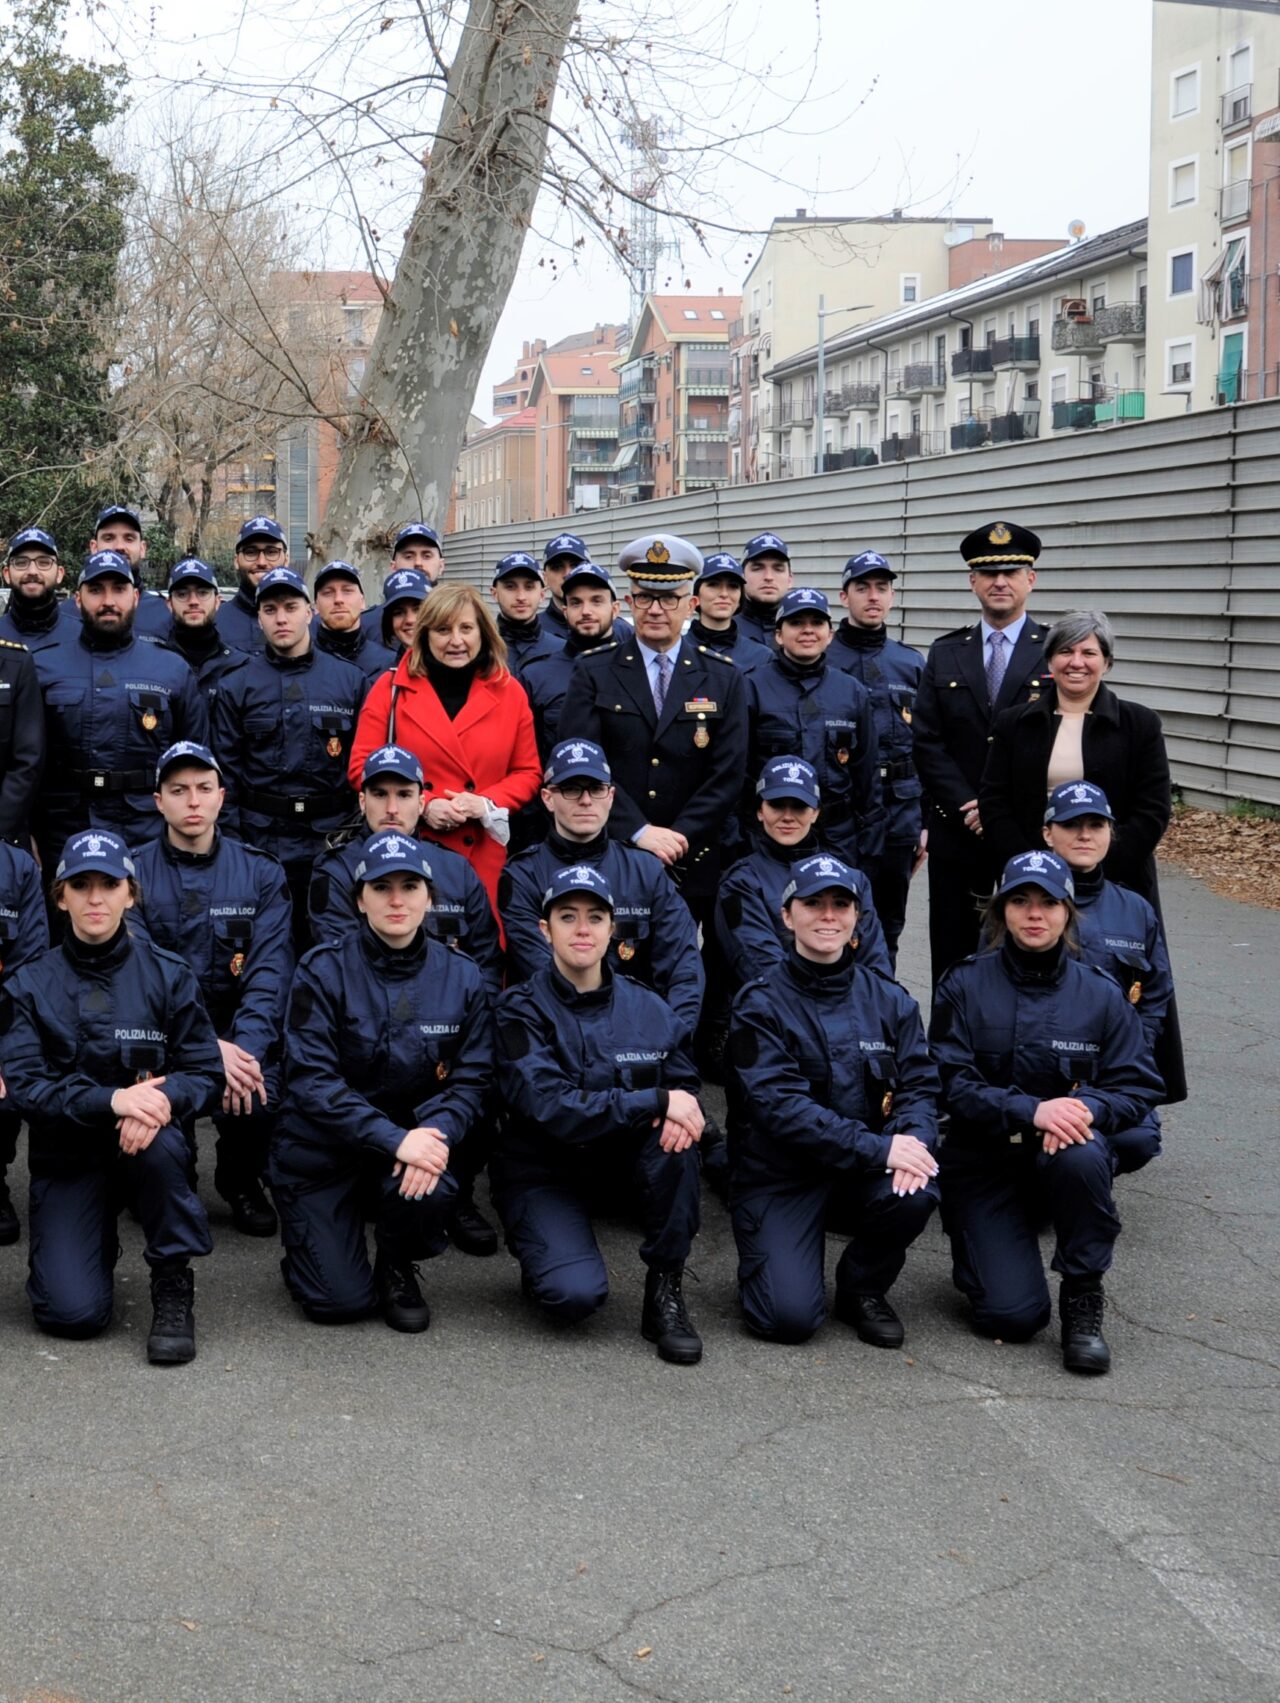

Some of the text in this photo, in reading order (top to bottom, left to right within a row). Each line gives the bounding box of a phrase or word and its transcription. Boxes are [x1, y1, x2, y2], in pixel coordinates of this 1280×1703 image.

[125, 683, 150, 691] POLIZIA
[309, 704, 333, 712] POLIZIA
[209, 906, 237, 916] POLIZIA
[1105, 938, 1129, 948] POLIZIA
[114, 1028, 146, 1040] POLIZIA
[859, 1040, 885, 1051] POLIZIA
[1052, 1039, 1084, 1051] POLIZIA
[616, 1052, 640, 1063] OLIZIA
